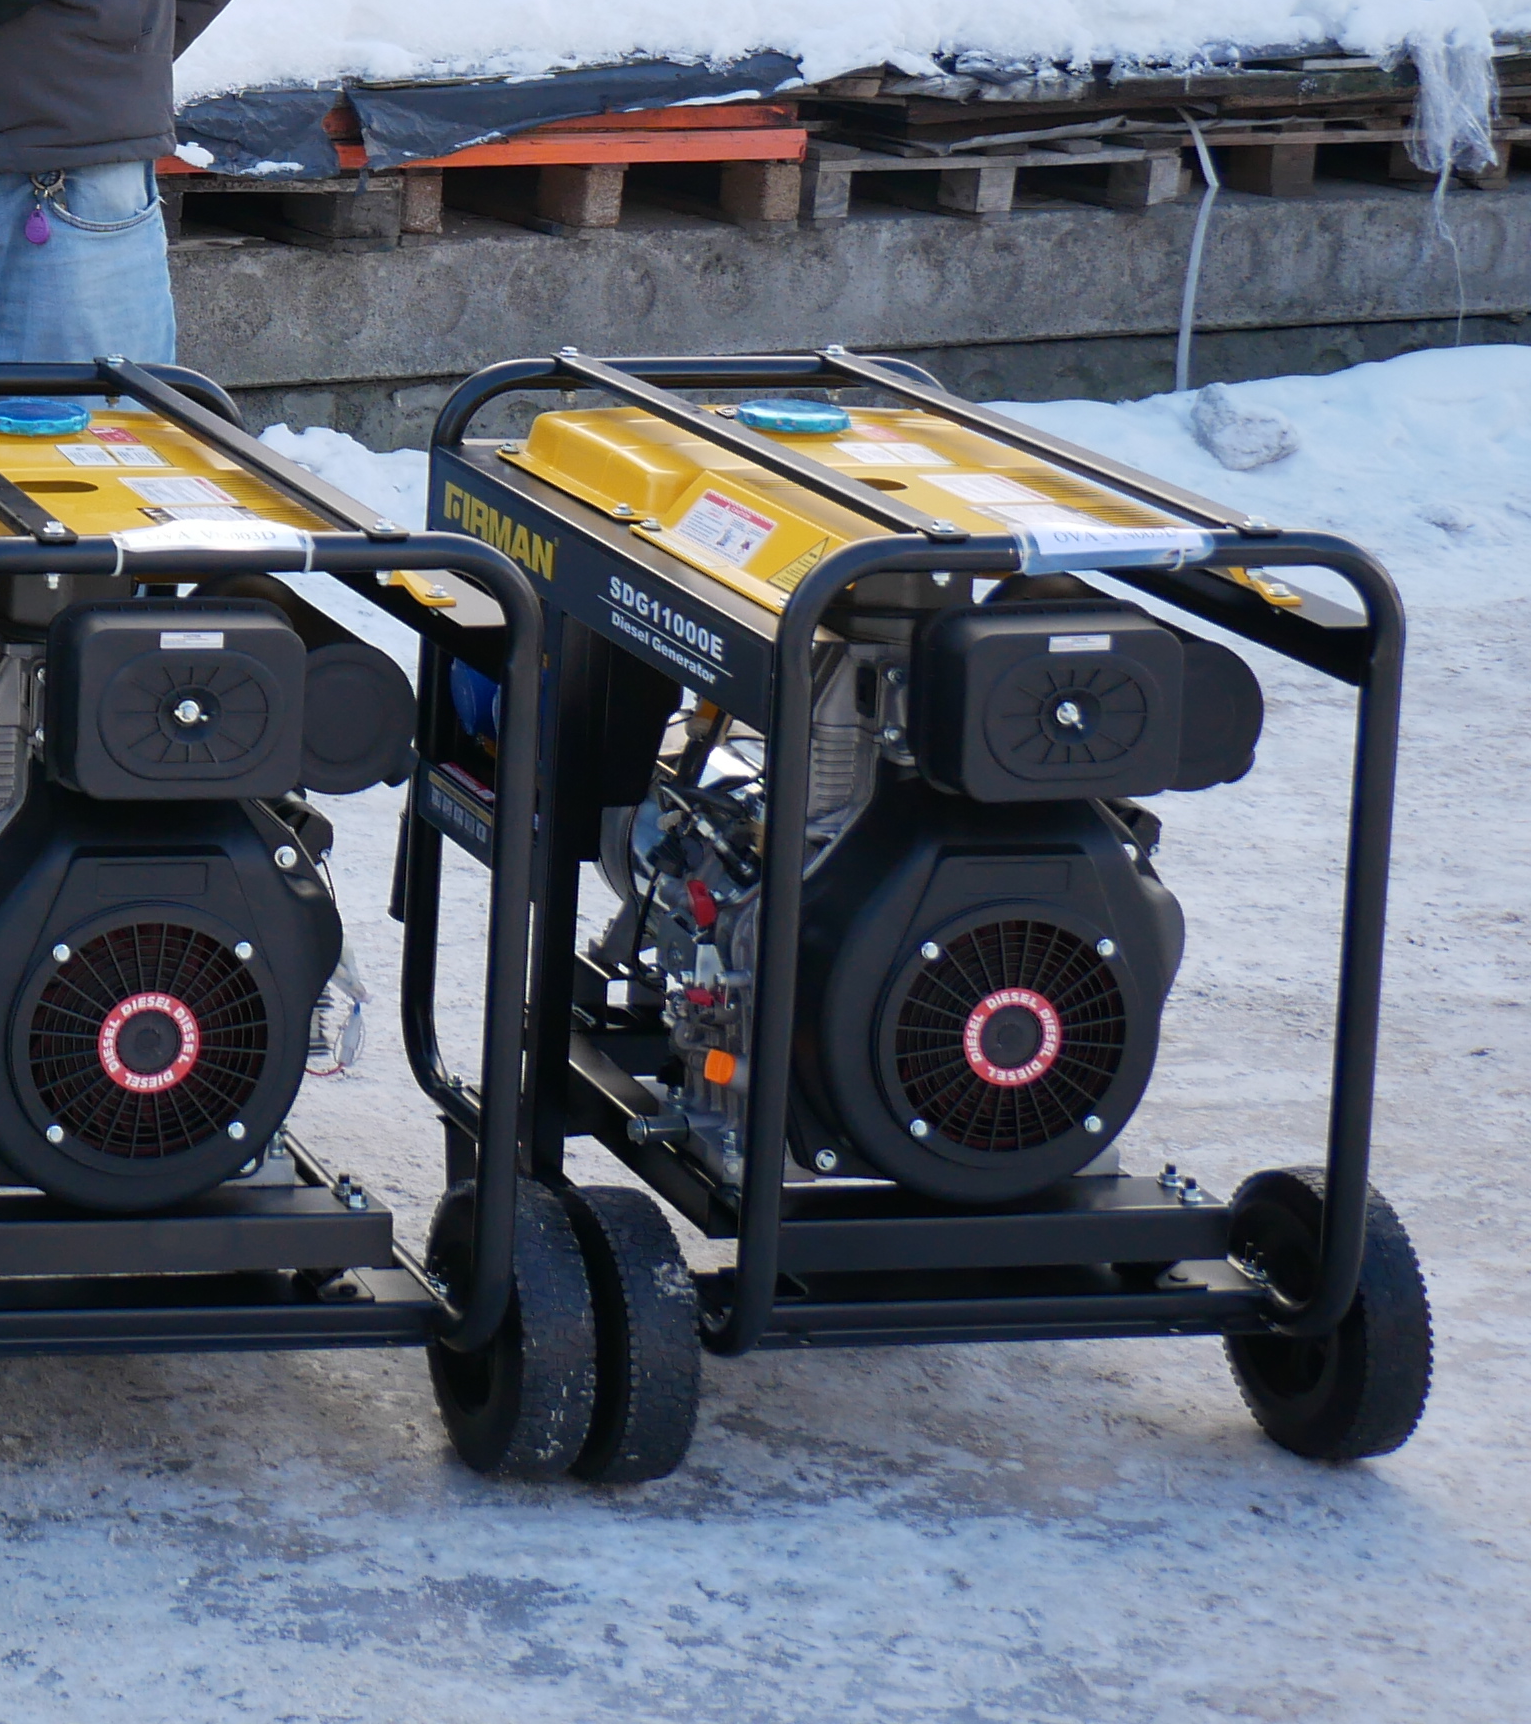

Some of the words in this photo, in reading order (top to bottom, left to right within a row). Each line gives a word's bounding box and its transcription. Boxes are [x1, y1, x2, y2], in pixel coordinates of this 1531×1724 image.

[609, 576, 723, 661] SDG11000E
[611, 611, 649, 645] Diesel
[652, 636, 716, 684] Generator
[121, 996, 171, 1017] DIESEL
[986, 992, 1037, 1009] DIESEL
[103, 1019, 120, 1073] DIESEL
[173, 1006, 194, 1063] DIESEL
[966, 1014, 984, 1062] DIESEL
[1039, 1008, 1056, 1057] DIESEL
[125, 1070, 174, 1088] DIESEL
[988, 1060, 1042, 1081] DIESEL
